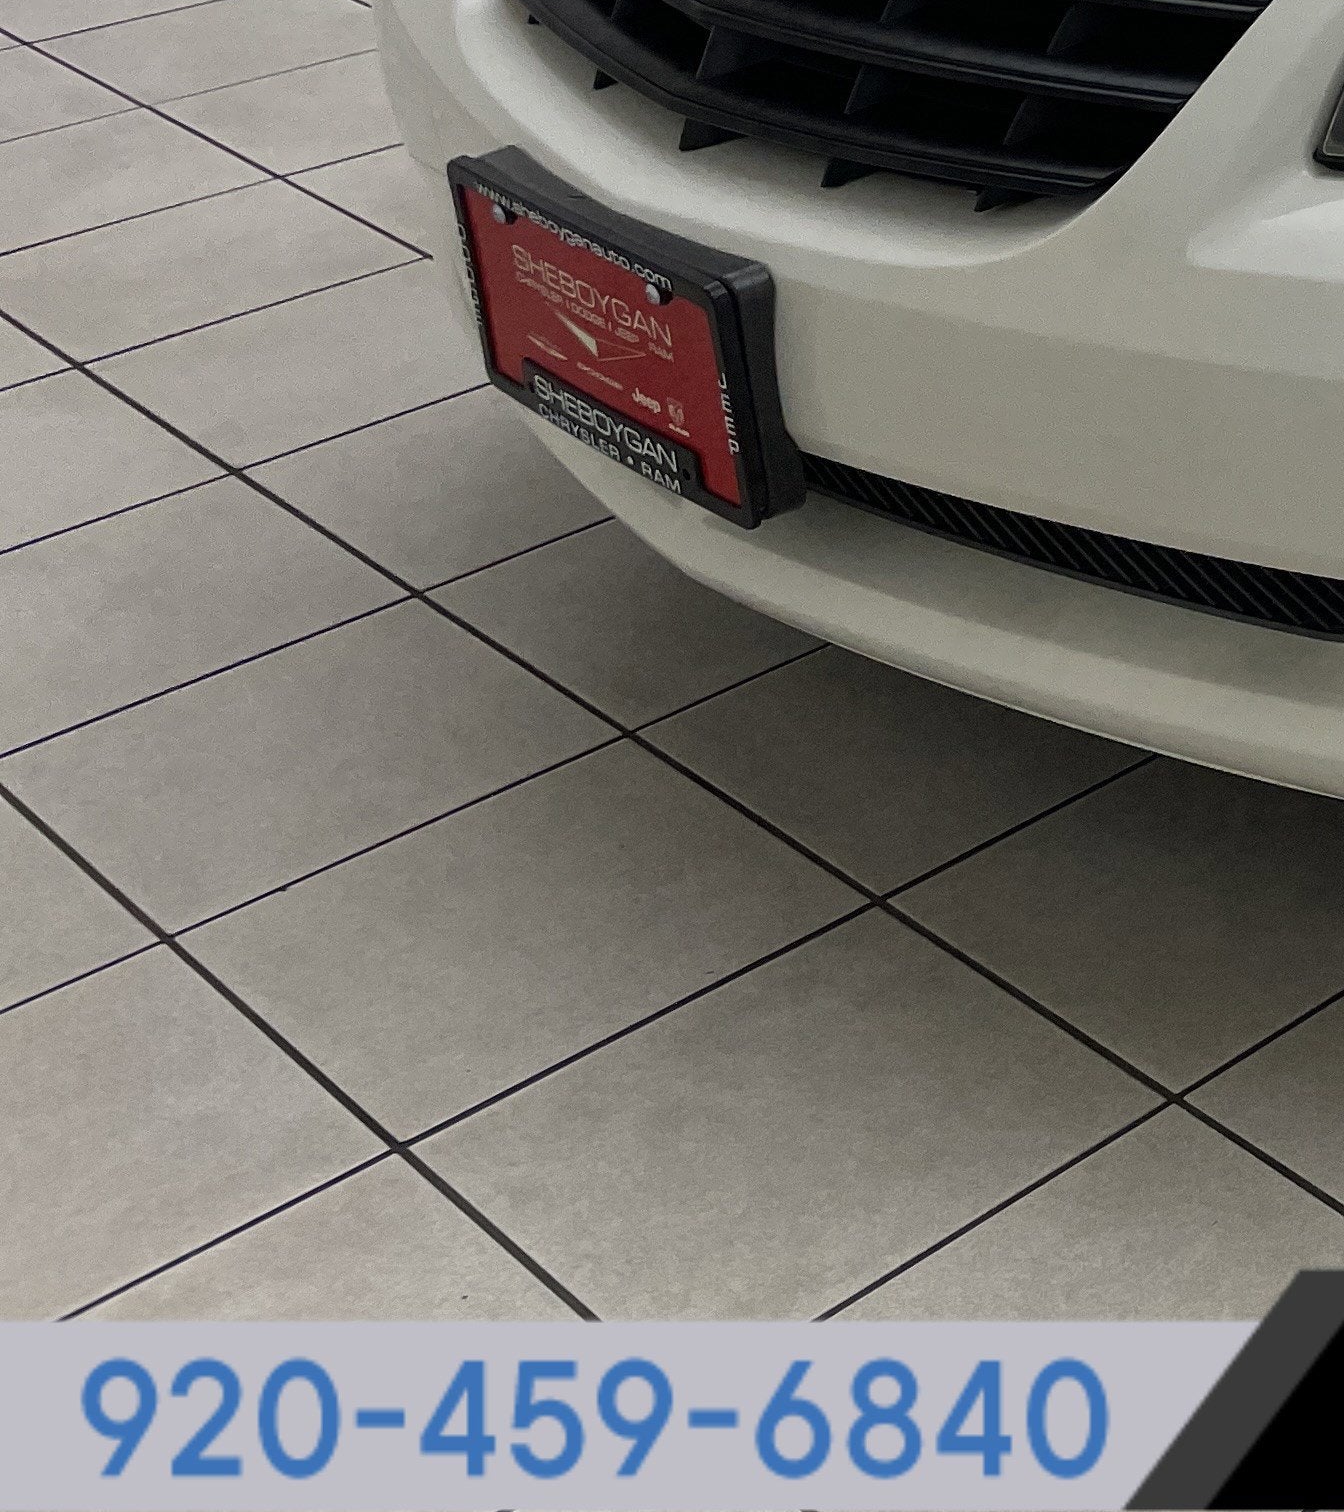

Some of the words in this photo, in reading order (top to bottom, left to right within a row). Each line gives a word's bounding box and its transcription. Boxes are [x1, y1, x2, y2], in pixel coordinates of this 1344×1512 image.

[475, 181, 673, 291] www.sheboyganauto.com
[512, 244, 672, 348] SHEBOYGAN
[534, 374, 678, 474] SHEBOYGAN
[538, 402, 622, 462] CHRYSLER
[641, 460, 682, 495] RAM
[631, 387, 661, 414] Jeep
[718, 372, 741, 456] JEEP
